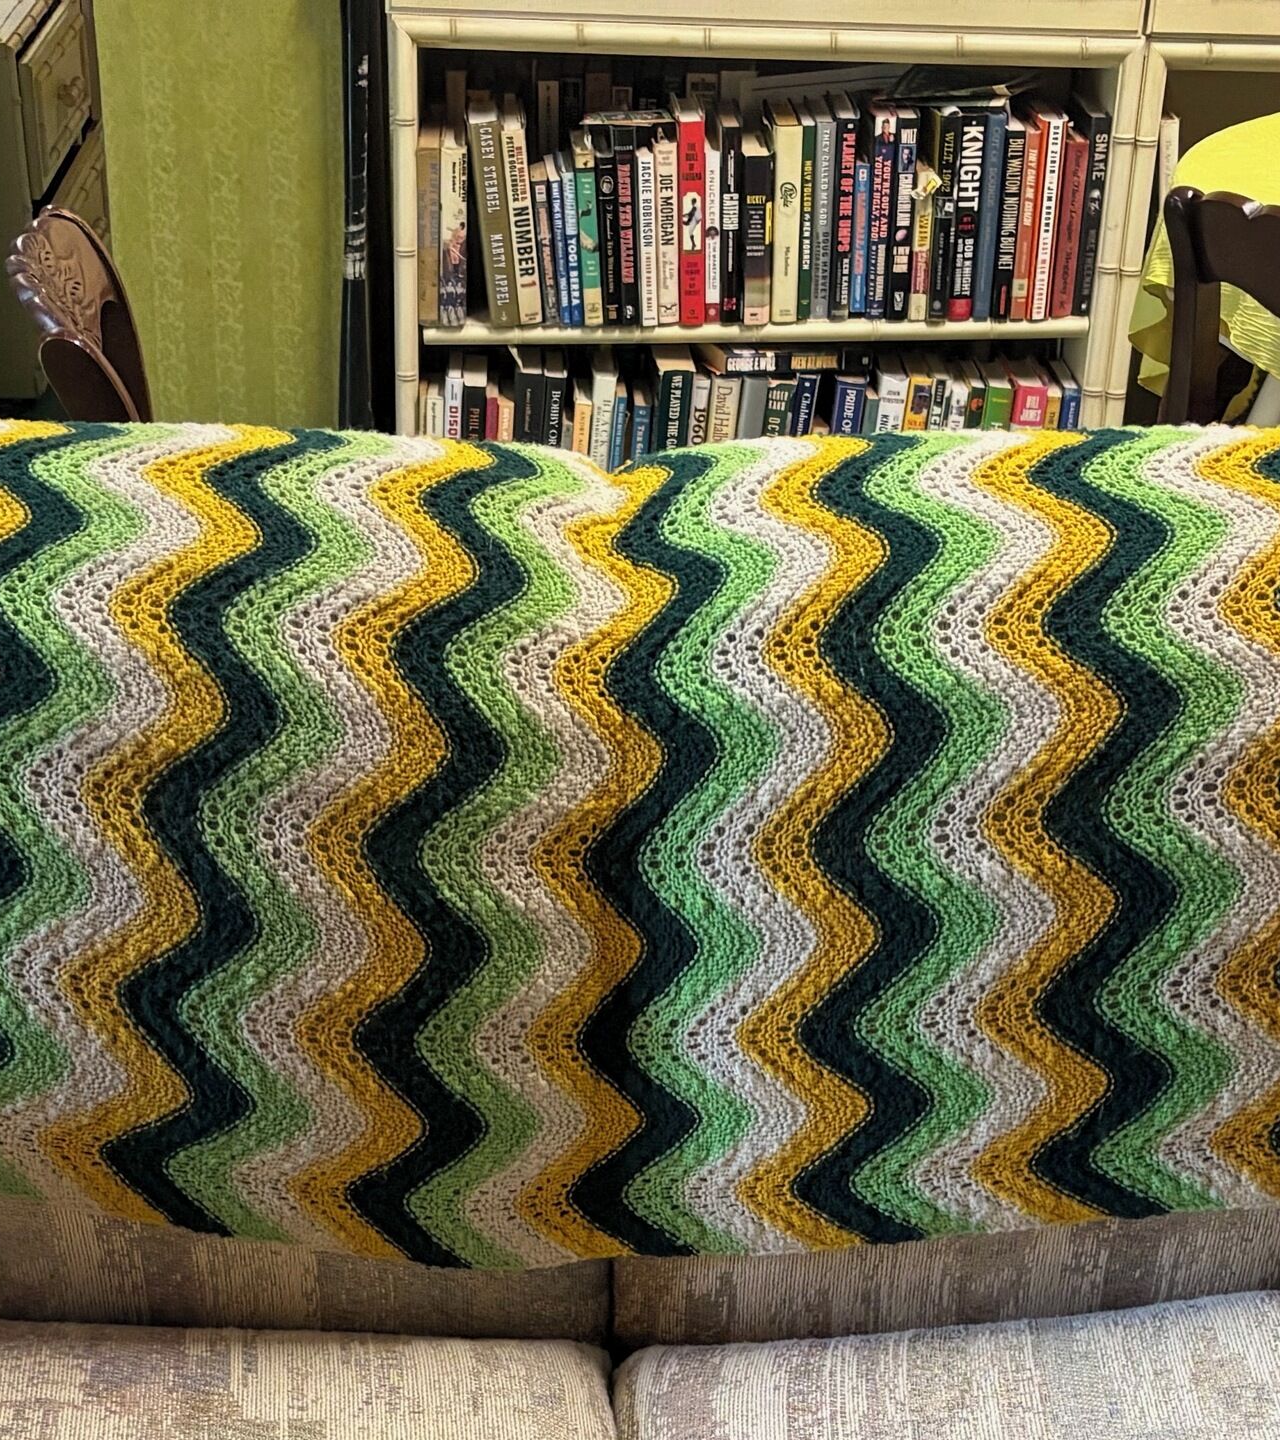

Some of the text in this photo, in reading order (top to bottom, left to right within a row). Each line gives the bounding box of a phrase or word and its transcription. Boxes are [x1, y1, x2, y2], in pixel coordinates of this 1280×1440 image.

[506, 136, 514, 157] PETER
[900, 128, 917, 144] WILT
[1051, 125, 1060, 147] DAVE
[479, 126, 500, 213] CASEY STENGEL
[804, 160, 813, 179] HOLY
[873, 155, 883, 190] YOU'RE
[957, 126, 984, 212] KNIGHT
[1092, 133, 1108, 182] SNAKE
[659, 173, 673, 194] JOE
[819, 129, 830, 226] THEY CALLED ME GOD
[837, 133, 856, 252] PLANET OF THE UMPS
[940, 168, 953, 193] 1962
[1023, 148, 1038, 227] THEY CALL ME COACH
[1046, 186, 1055, 203] JIM
[640, 161, 653, 248] JACKIE ROBINSON
[723, 193, 739, 230] CATFISH
[803, 181, 812, 214] TOLEDO
[880, 160, 891, 238] YOU'RE OUT AND
[998, 138, 1024, 271] BILL WALTON NOTHING BUT NET
[661, 195, 675, 247] MORGAN
[803, 222, 811, 238] KEN
[1044, 205, 1053, 234] BROWN
[512, 206, 536, 288] NUMBER 1
[568, 236, 577, 267] YOGI
[820, 232, 829, 301] DOUG HARVEY
[490, 233, 510, 306] MARTY APPEL
[840, 258, 850, 305] KEN KAISER
[961, 238, 974, 296] BOB KNIGHT
[570, 270, 580, 305] BERRA
[469, 408, 480, 431] PHIL
[550, 390, 562, 428] BOBBY
[666, 375, 683, 438] WE PLAYED THE
[715, 386, 732, 415] David
[842, 389, 857, 421] PRIDE
[600, 399, 611, 447] BLACK
[691, 406, 707, 446] 1960
